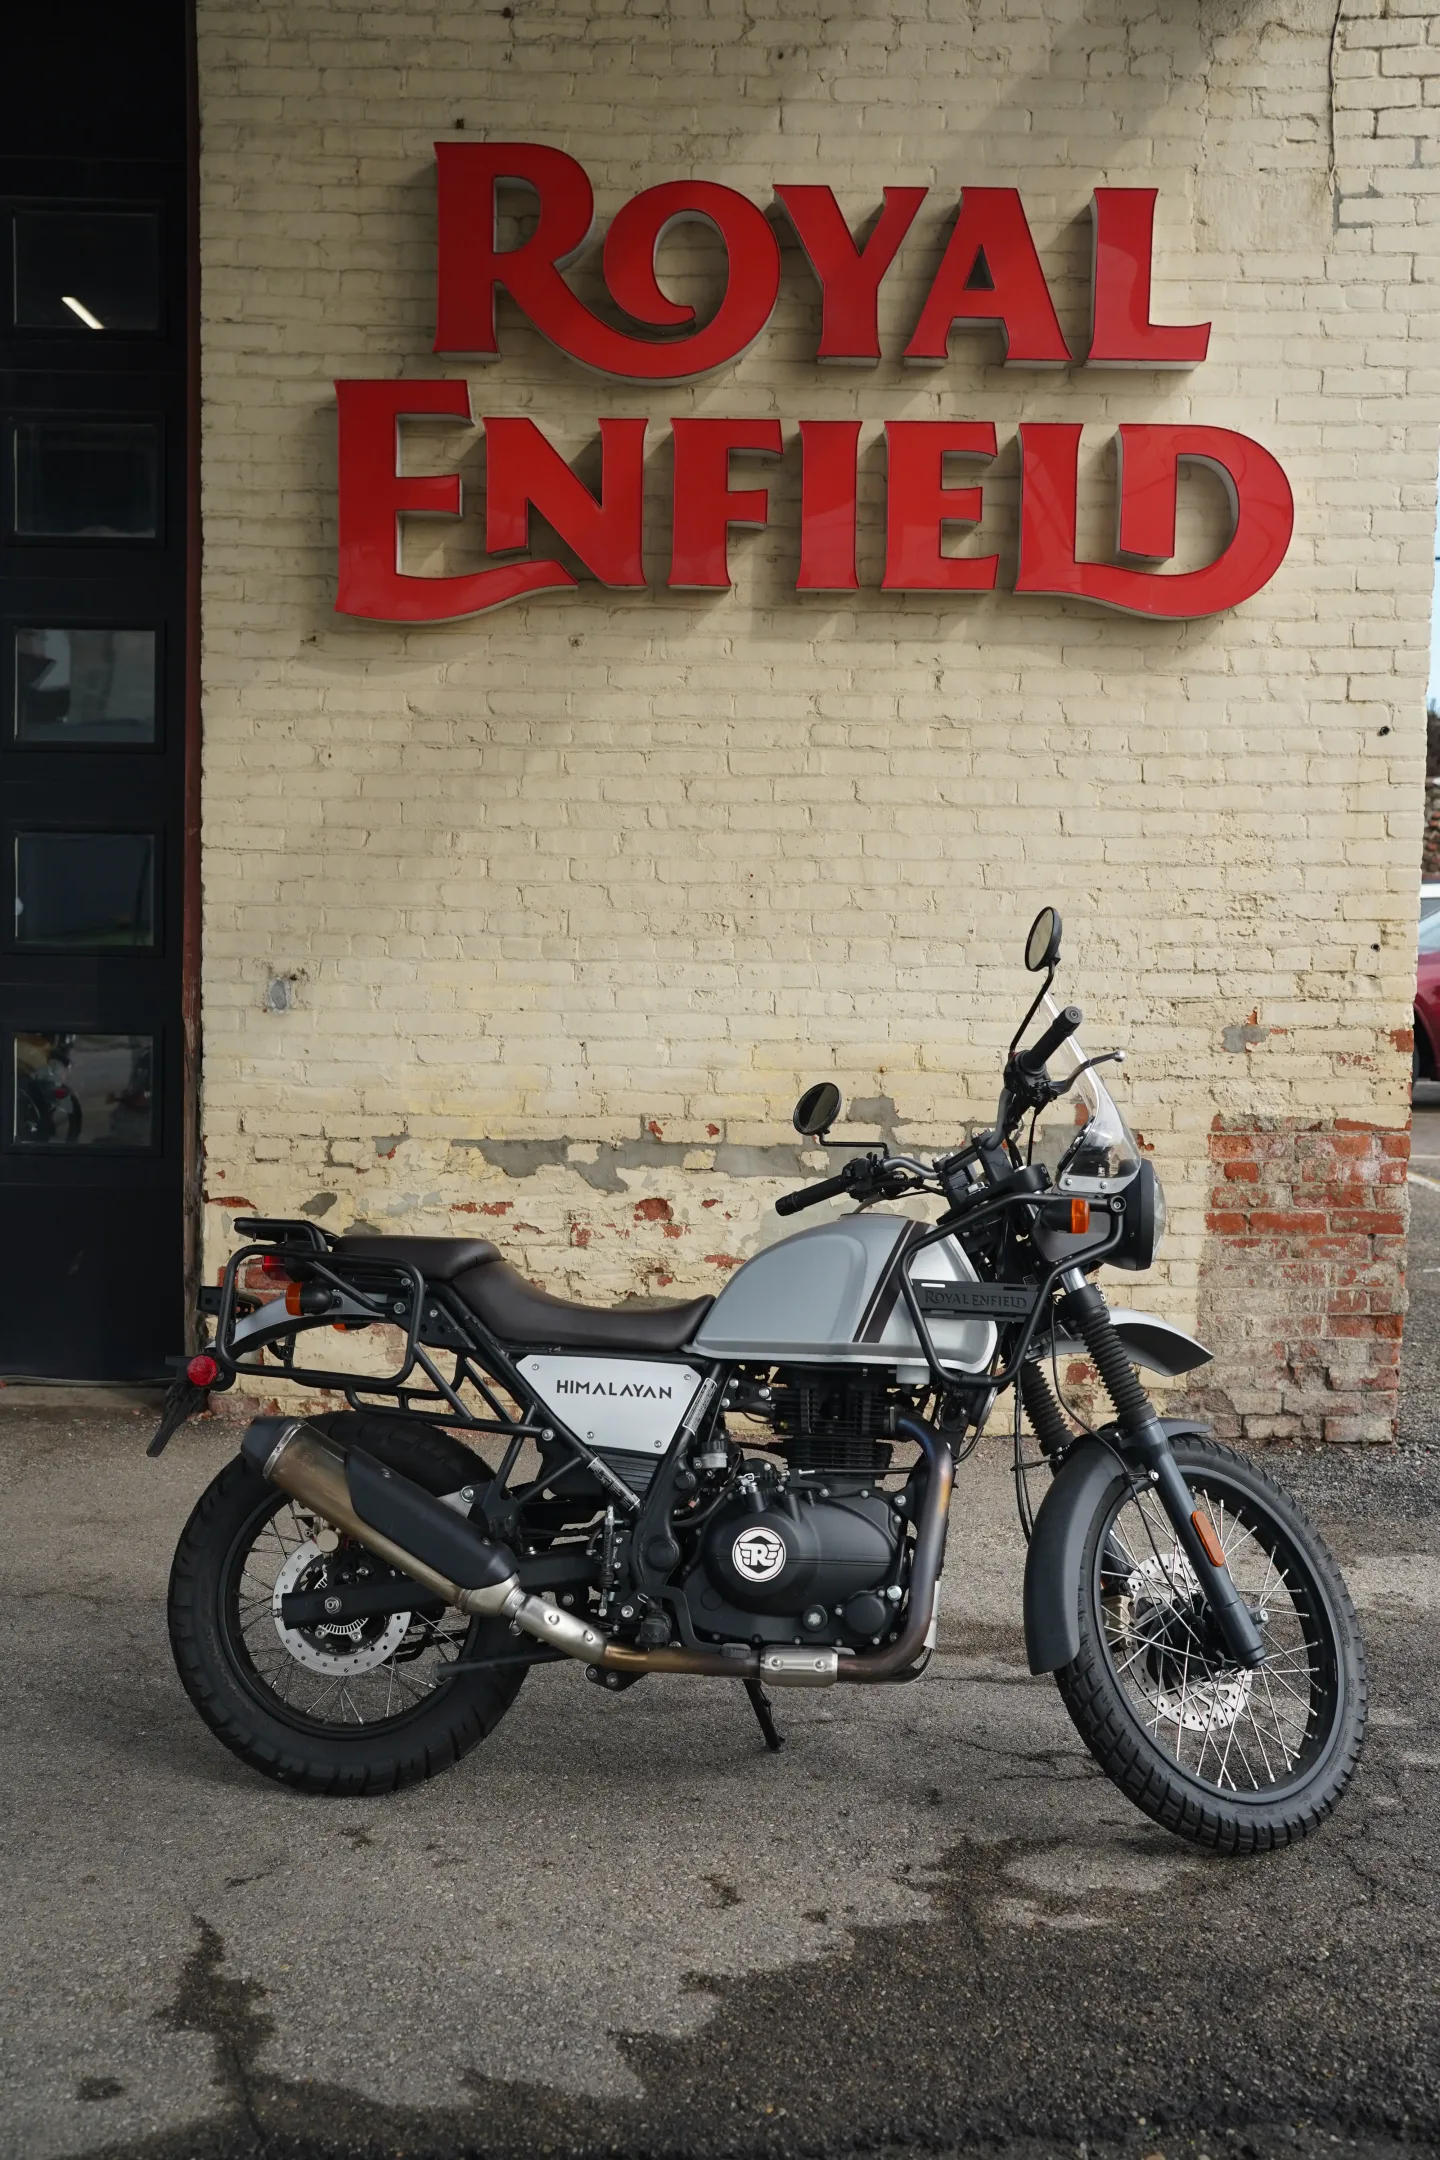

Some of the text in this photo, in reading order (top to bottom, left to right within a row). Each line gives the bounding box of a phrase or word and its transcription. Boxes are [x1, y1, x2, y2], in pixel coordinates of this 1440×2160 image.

[434, 142, 1212, 384] ROYAL
[334, 379, 1294, 624] ENFIELD
[925, 1290, 1027, 1309] ROYAL ENFIELD
[556, 1379, 672, 1399] HIMALAYAN
